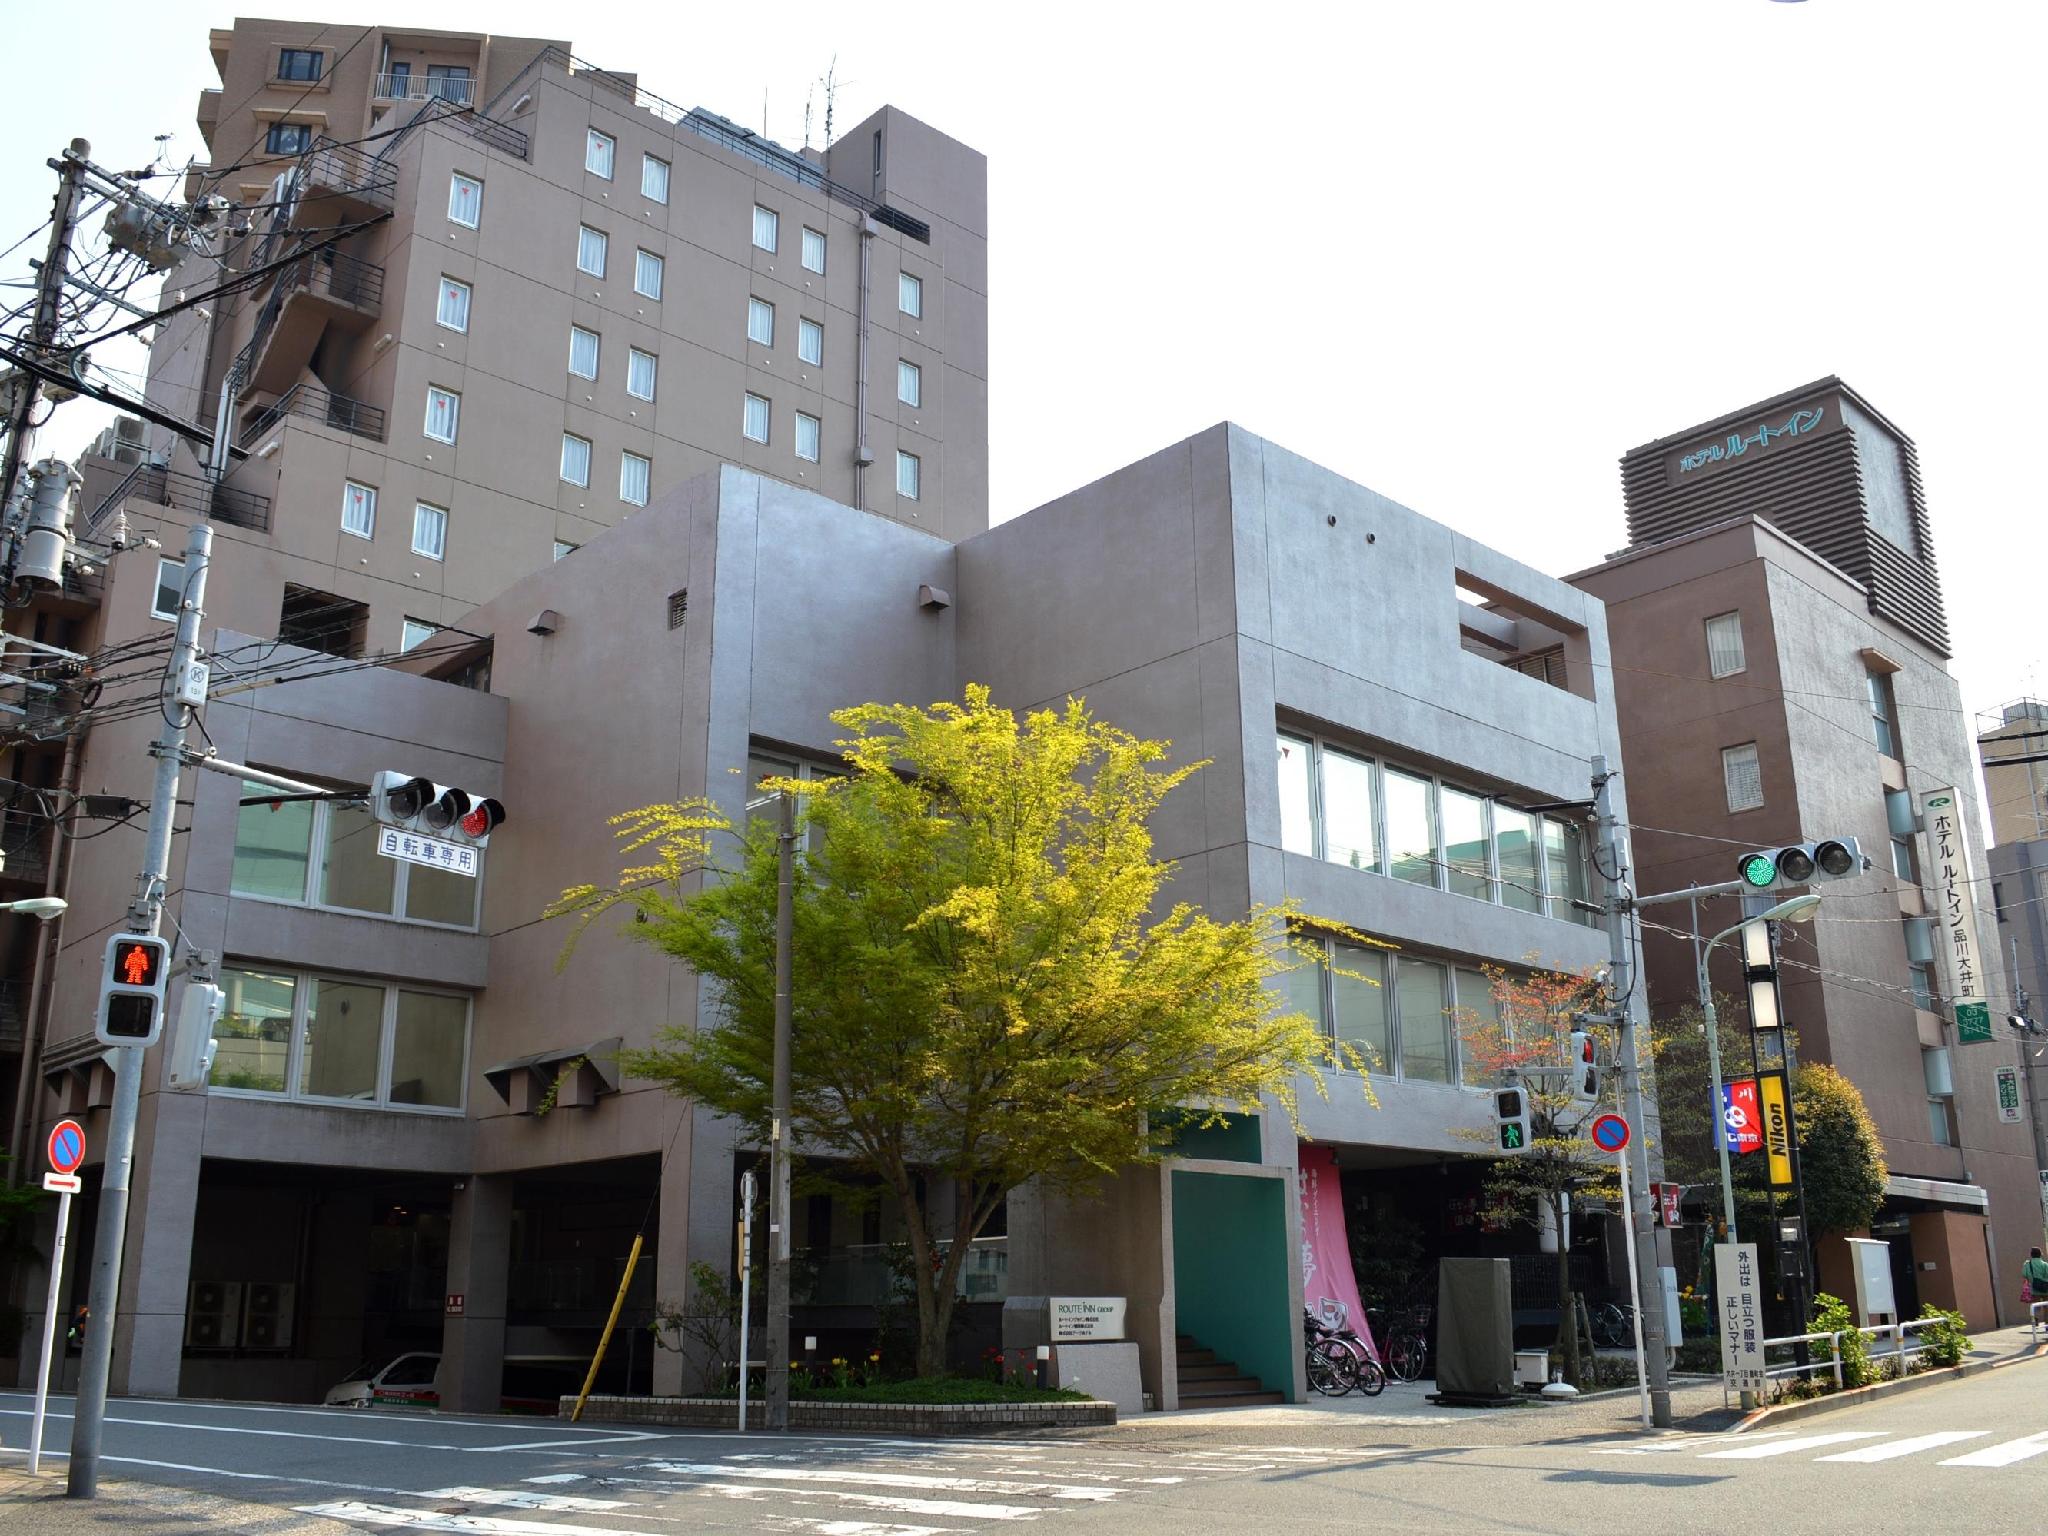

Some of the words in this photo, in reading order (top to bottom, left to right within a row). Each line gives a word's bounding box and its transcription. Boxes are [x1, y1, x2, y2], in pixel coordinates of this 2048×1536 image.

[1680, 445, 1724, 473] ホテル
[1725, 407, 1824, 460] ルートイン
[385, 832, 472, 870] 自転車専用
[1934, 815, 1955, 859] ホテル
[1769, 1103, 1786, 1156] Nikon
[1738, 1251, 1751, 1287] 外出は
[1058, 1304, 1082, 1314] ROUTE
[1726, 1296, 1740, 1366] 正しいマナー
[1741, 1293, 1756, 1353] 目立つ服装
